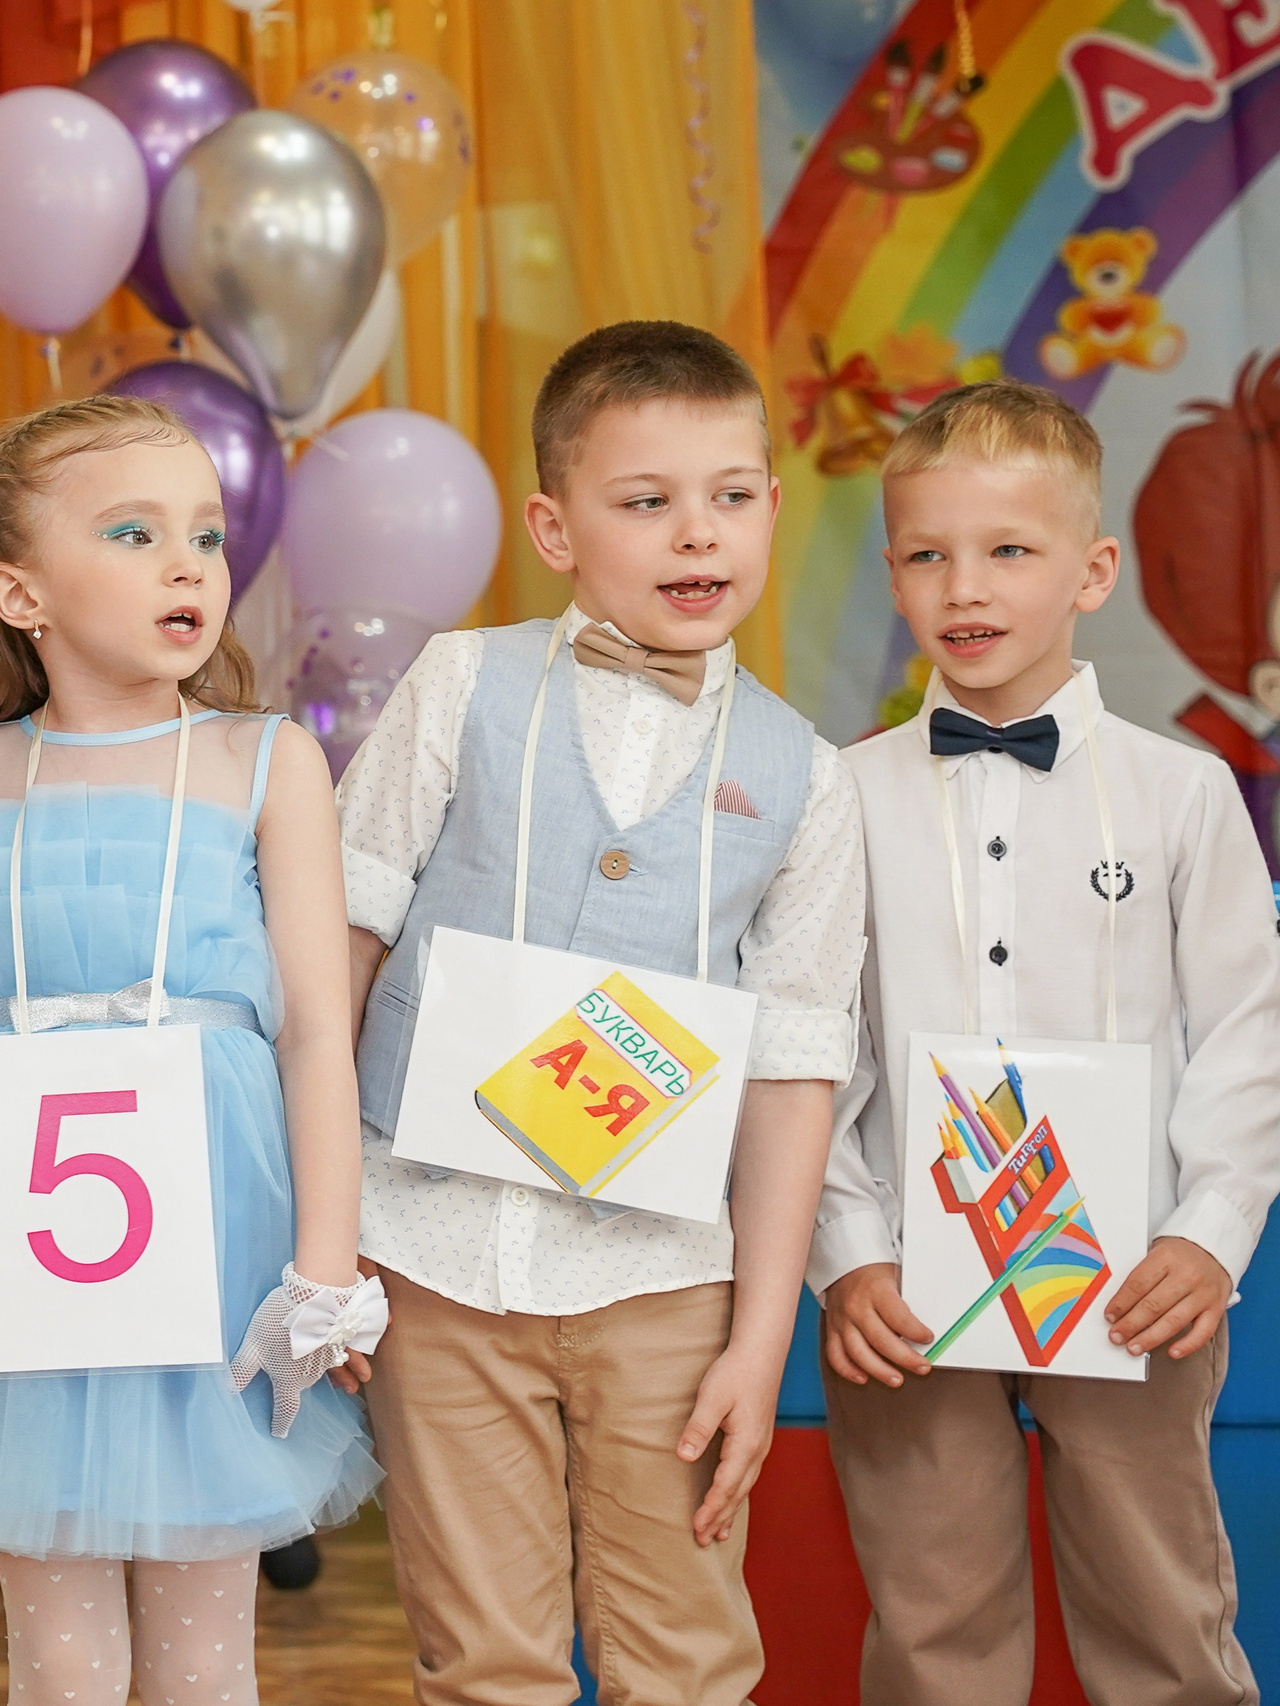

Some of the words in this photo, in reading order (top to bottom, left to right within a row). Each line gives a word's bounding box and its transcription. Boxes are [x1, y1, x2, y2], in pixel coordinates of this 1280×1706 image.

[529, 1039, 650, 1136] А-Я
[578, 992, 689, 1096] БУКВАРЬ
[27, 1090, 153, 1283] 5
